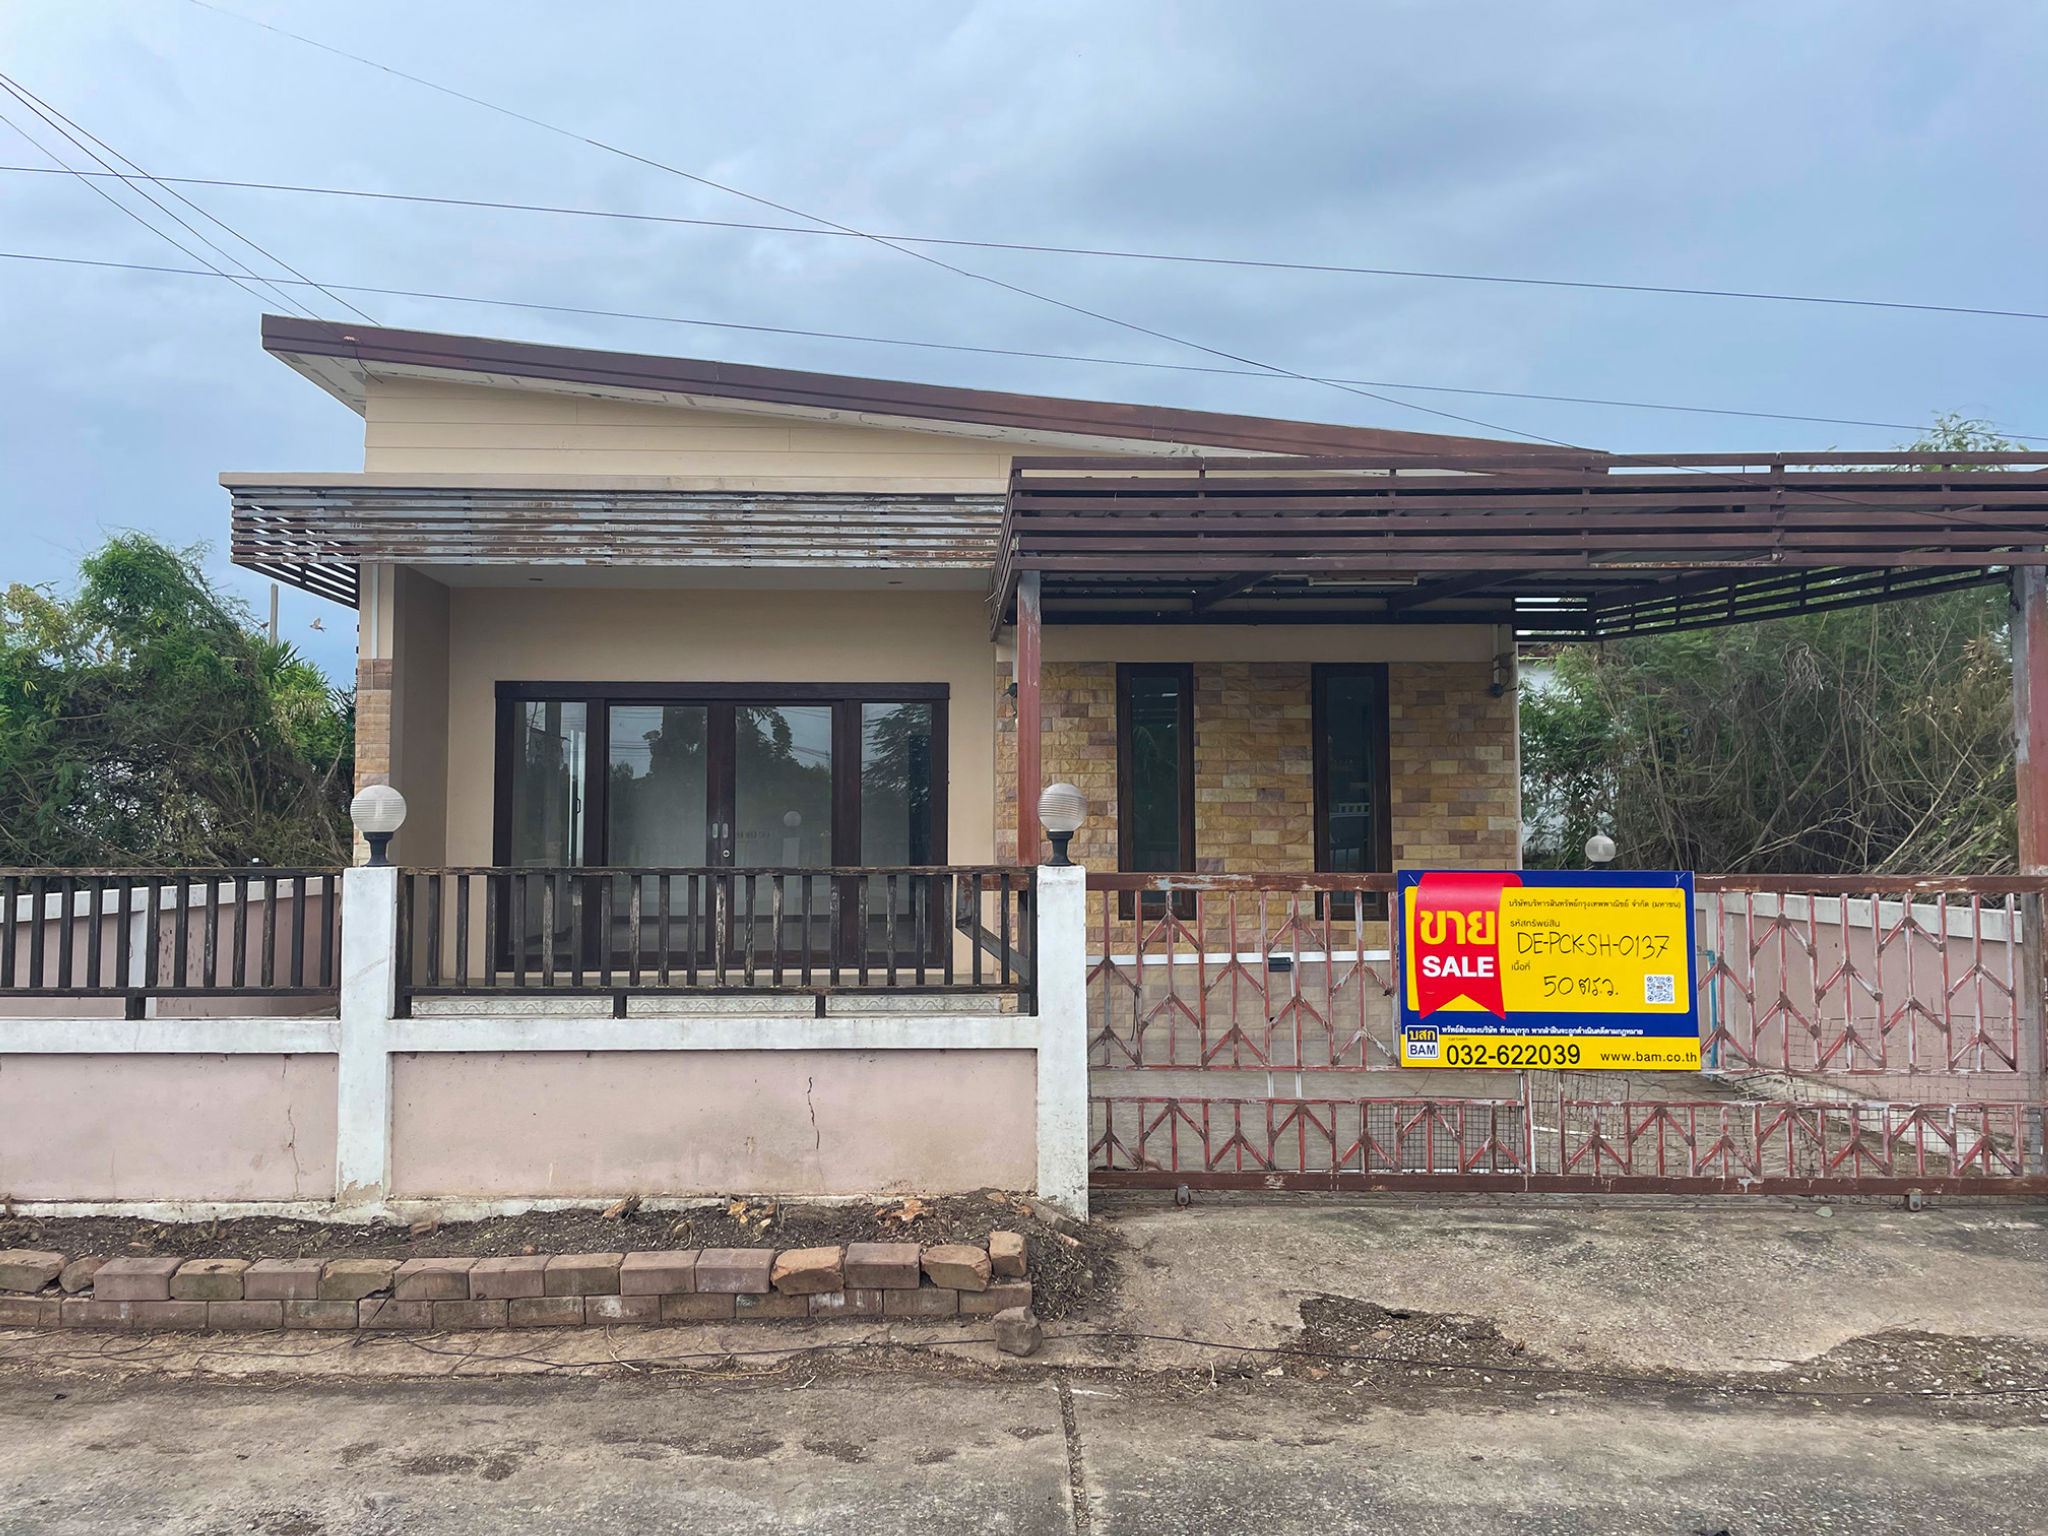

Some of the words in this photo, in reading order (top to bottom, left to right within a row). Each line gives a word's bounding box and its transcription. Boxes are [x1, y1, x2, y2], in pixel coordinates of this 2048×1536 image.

[1420, 910, 1496, 945] ขาย
[1517, 931, 1670, 960] DE-PCK-SH-0137
[1422, 955, 1495, 978] SALE
[1511, 959, 1530, 971] เนื้อที่
[1544, 975, 1574, 997] 50
[1409, 1029, 1436, 1041] บสก
[1409, 1044, 1436, 1055] BAM
[1446, 1044, 1580, 1065] 032-622039
[1600, 1051, 1698, 1062] www.bam.co.th
